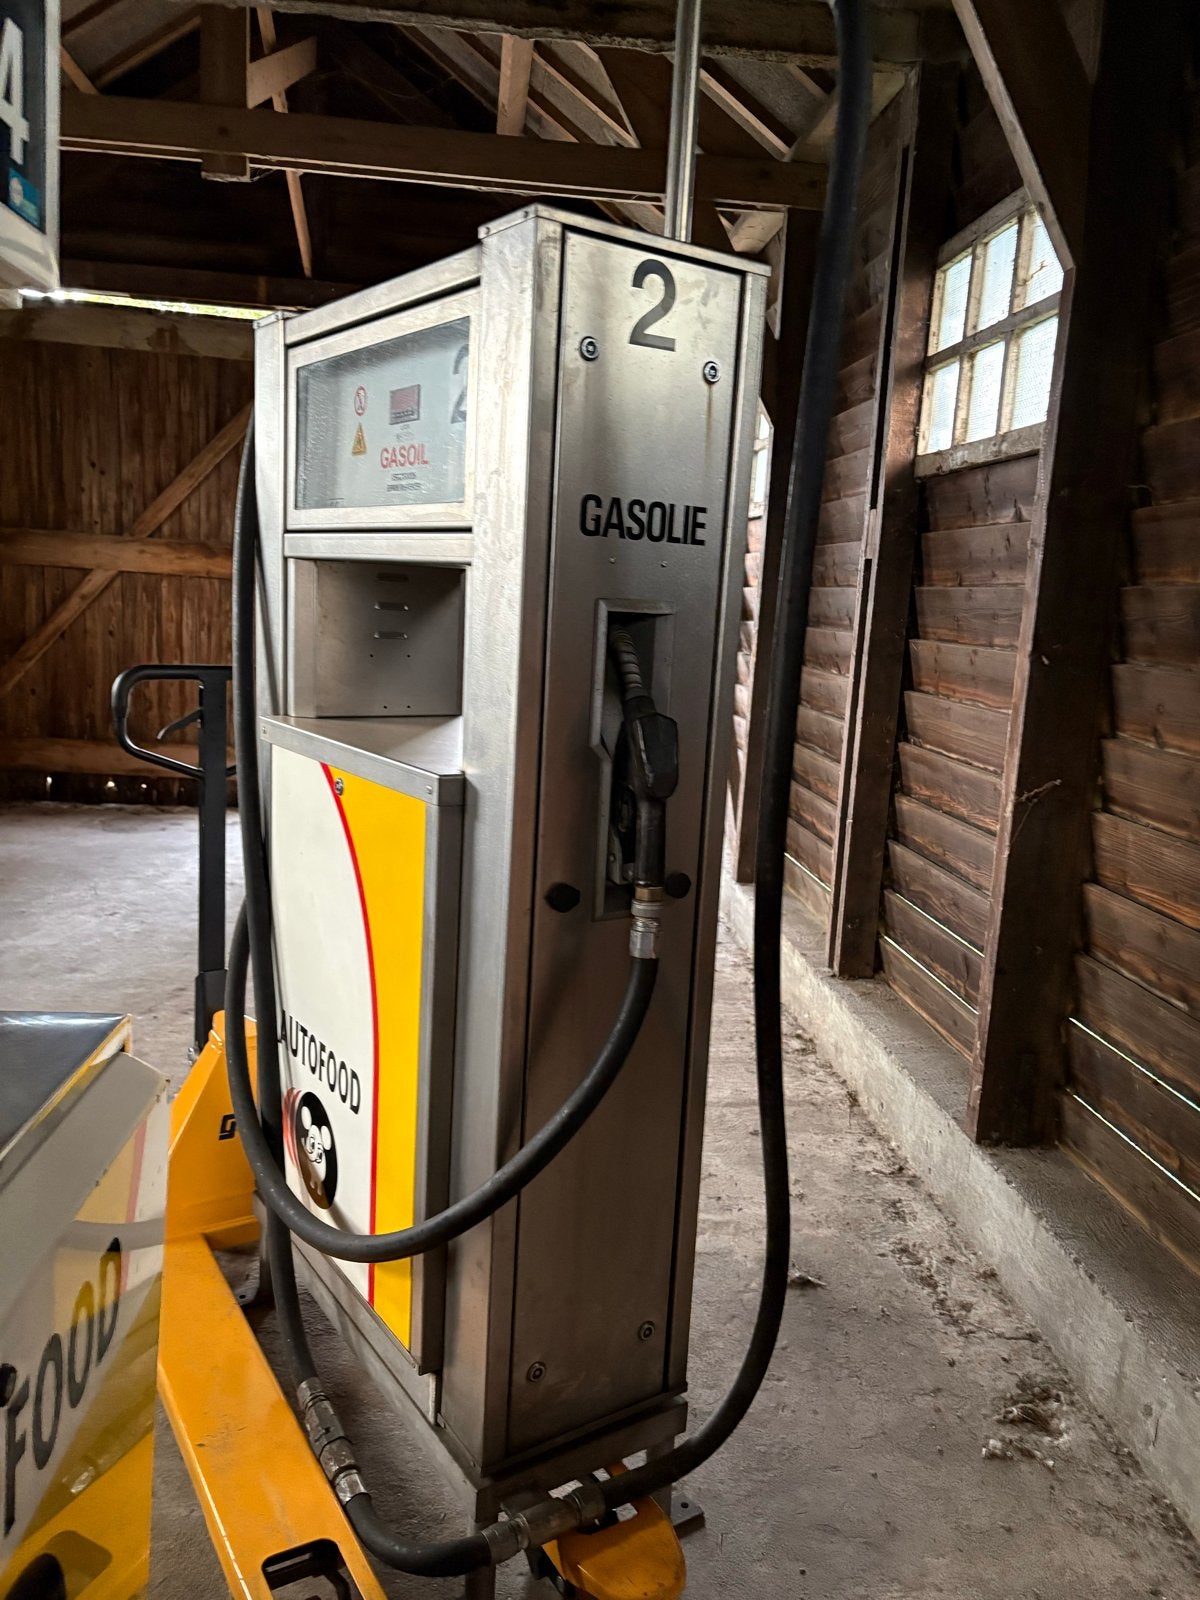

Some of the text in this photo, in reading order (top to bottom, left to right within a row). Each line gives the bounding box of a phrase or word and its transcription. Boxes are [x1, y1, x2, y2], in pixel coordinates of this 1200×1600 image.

[628, 258, 677, 352] 2
[380, 442, 430, 469] GASOIL
[579, 494, 708, 546] GASOLIE
[277, 1009, 361, 1115] AUTOFOOD
